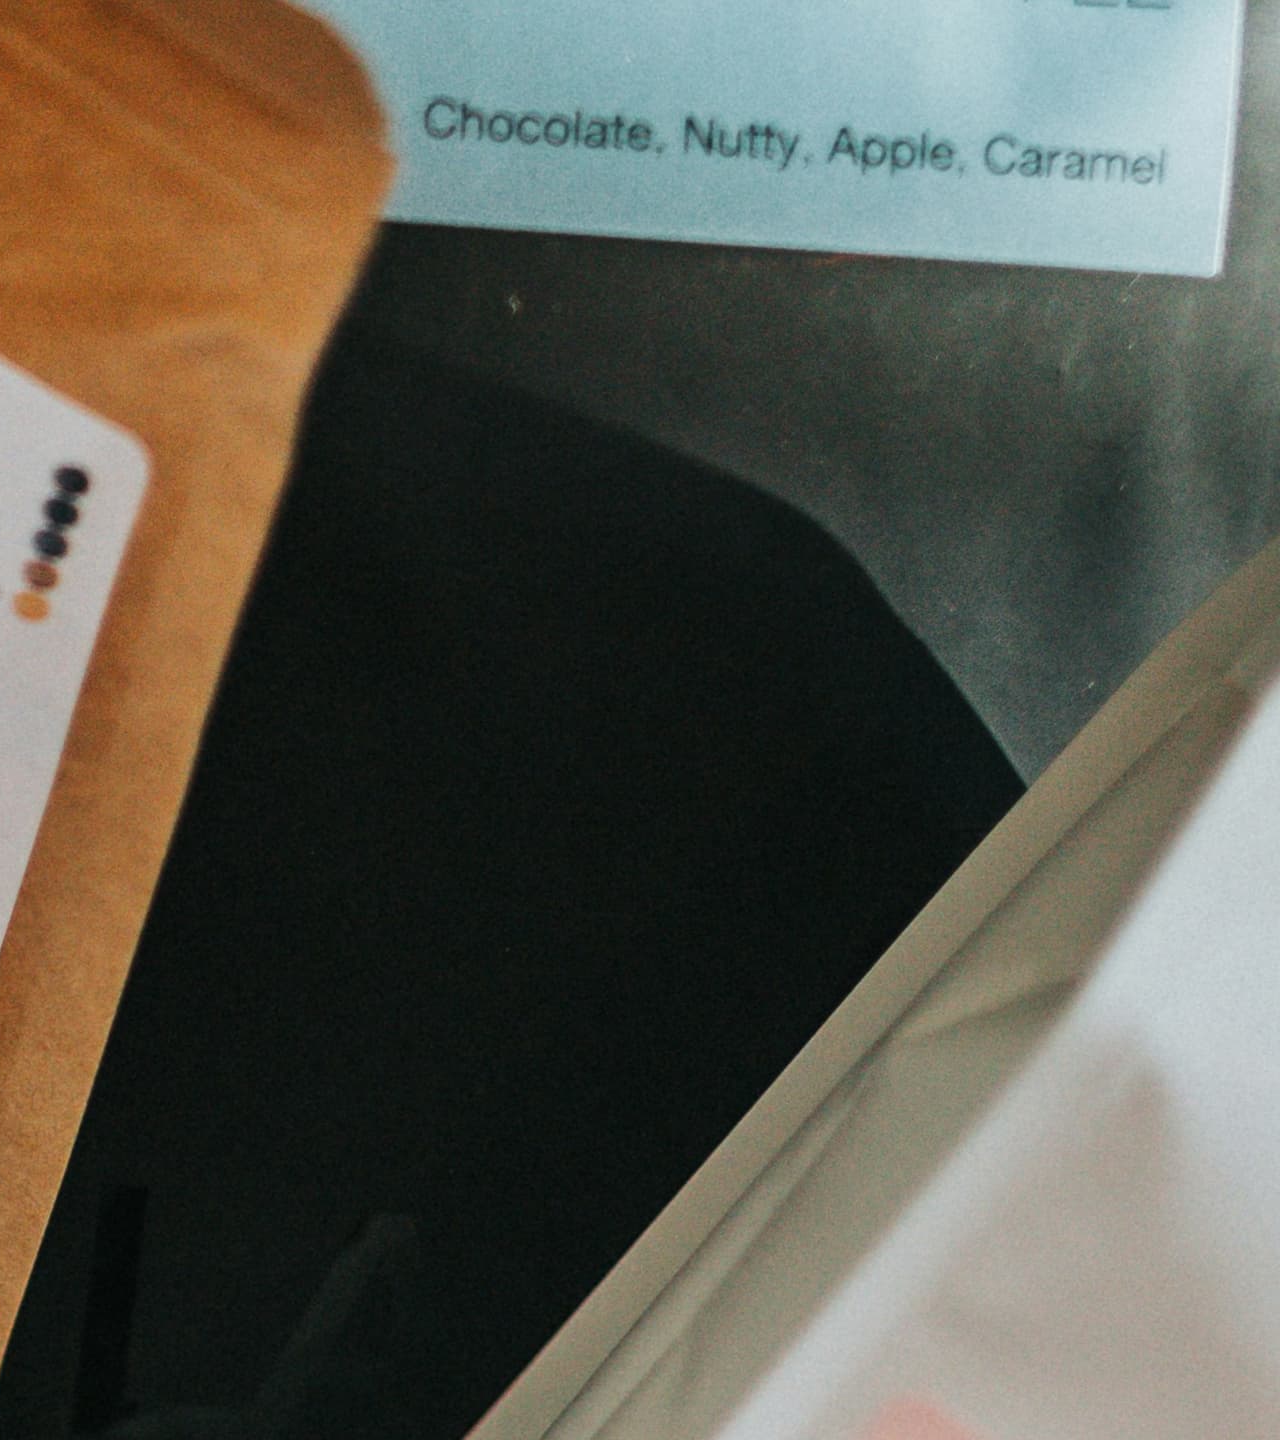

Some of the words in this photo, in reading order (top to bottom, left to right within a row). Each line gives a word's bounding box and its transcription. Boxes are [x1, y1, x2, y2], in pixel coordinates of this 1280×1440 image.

[422, 95, 666, 155] Chocolate,
[684, 115, 810, 173] Nutty,
[828, 125, 964, 178] Apple,
[983, 134, 1169, 186] Caramel
